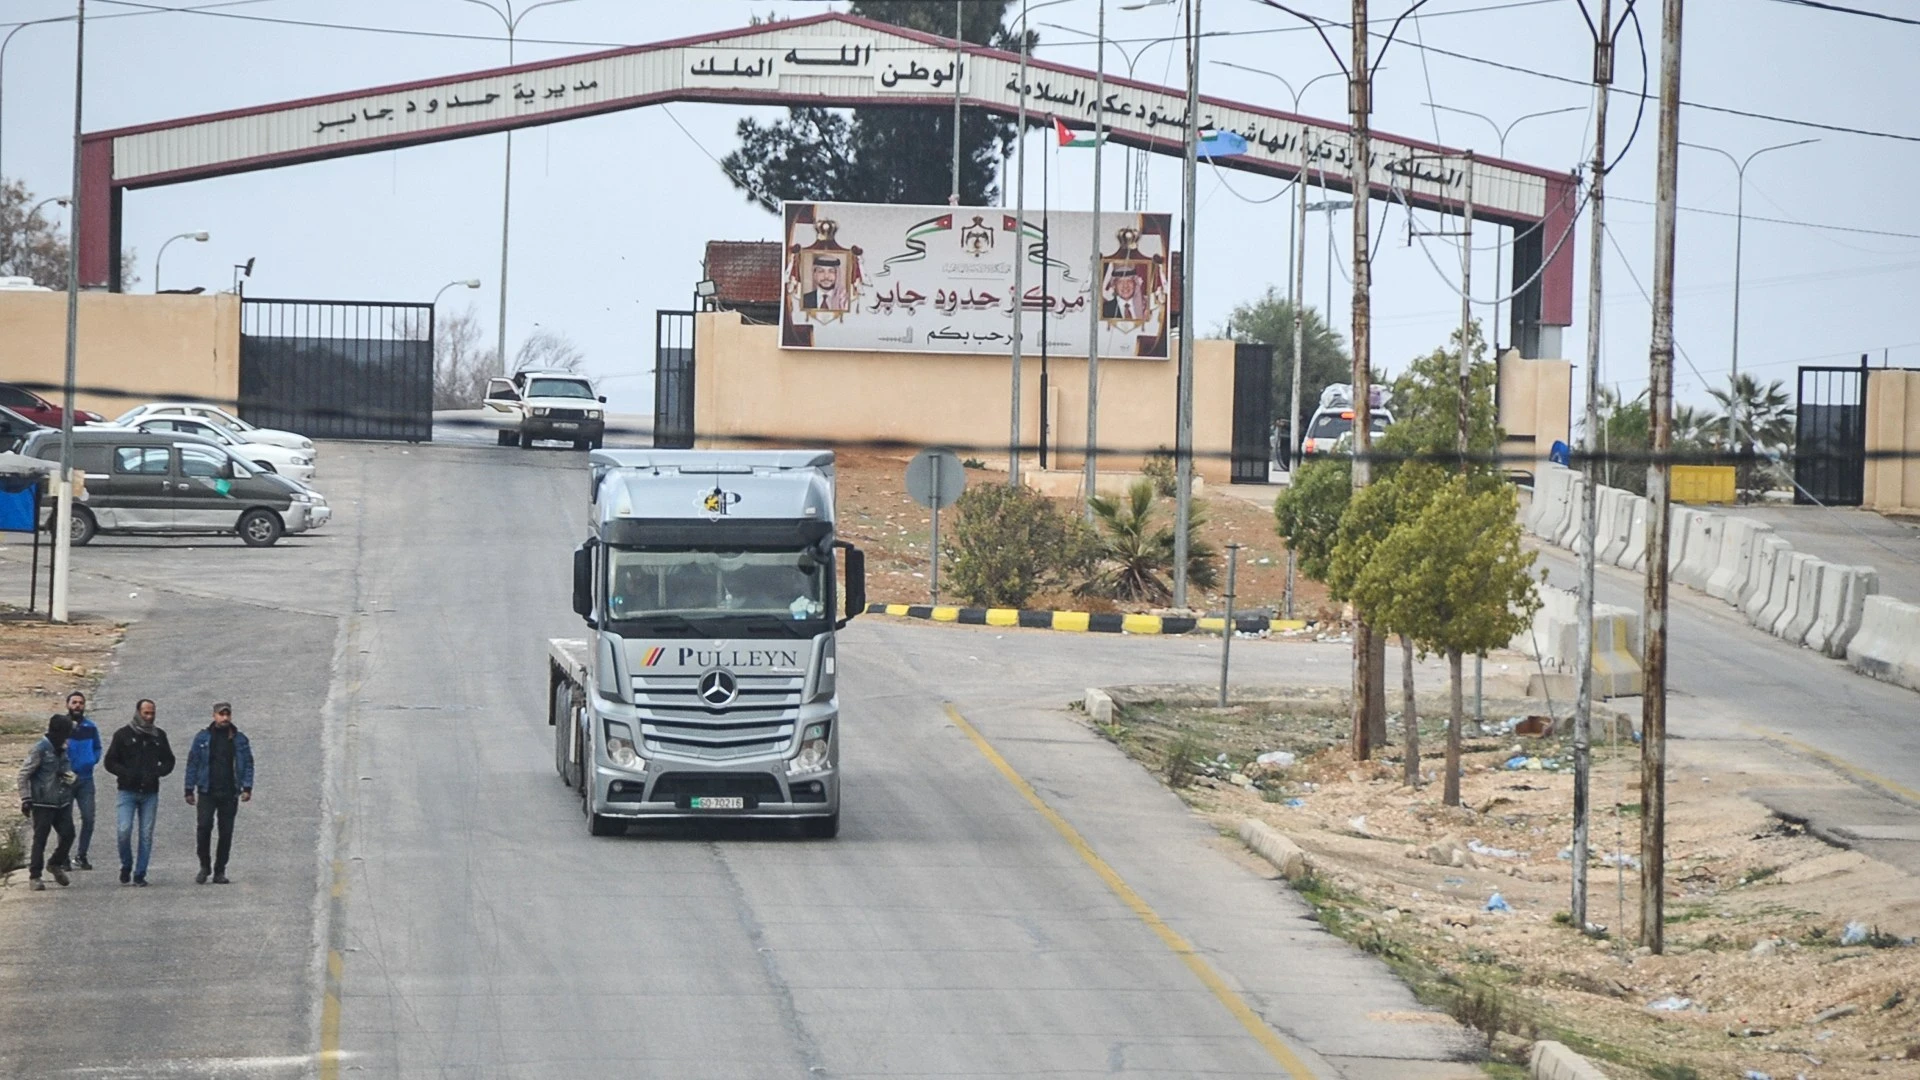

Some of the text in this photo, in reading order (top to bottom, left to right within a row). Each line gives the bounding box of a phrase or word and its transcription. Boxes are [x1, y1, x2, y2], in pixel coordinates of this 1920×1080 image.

[690, 56, 773, 78] الملك
[784, 43, 871, 67] الله
[881, 61, 964, 88] الوطن
[313, 78, 599, 134] مديرية حدود جابر
[867, 281, 1085, 318] مركز حدود جابر
[926, 325, 969, 345] بكم
[678, 647, 798, 667] PULLEYN
